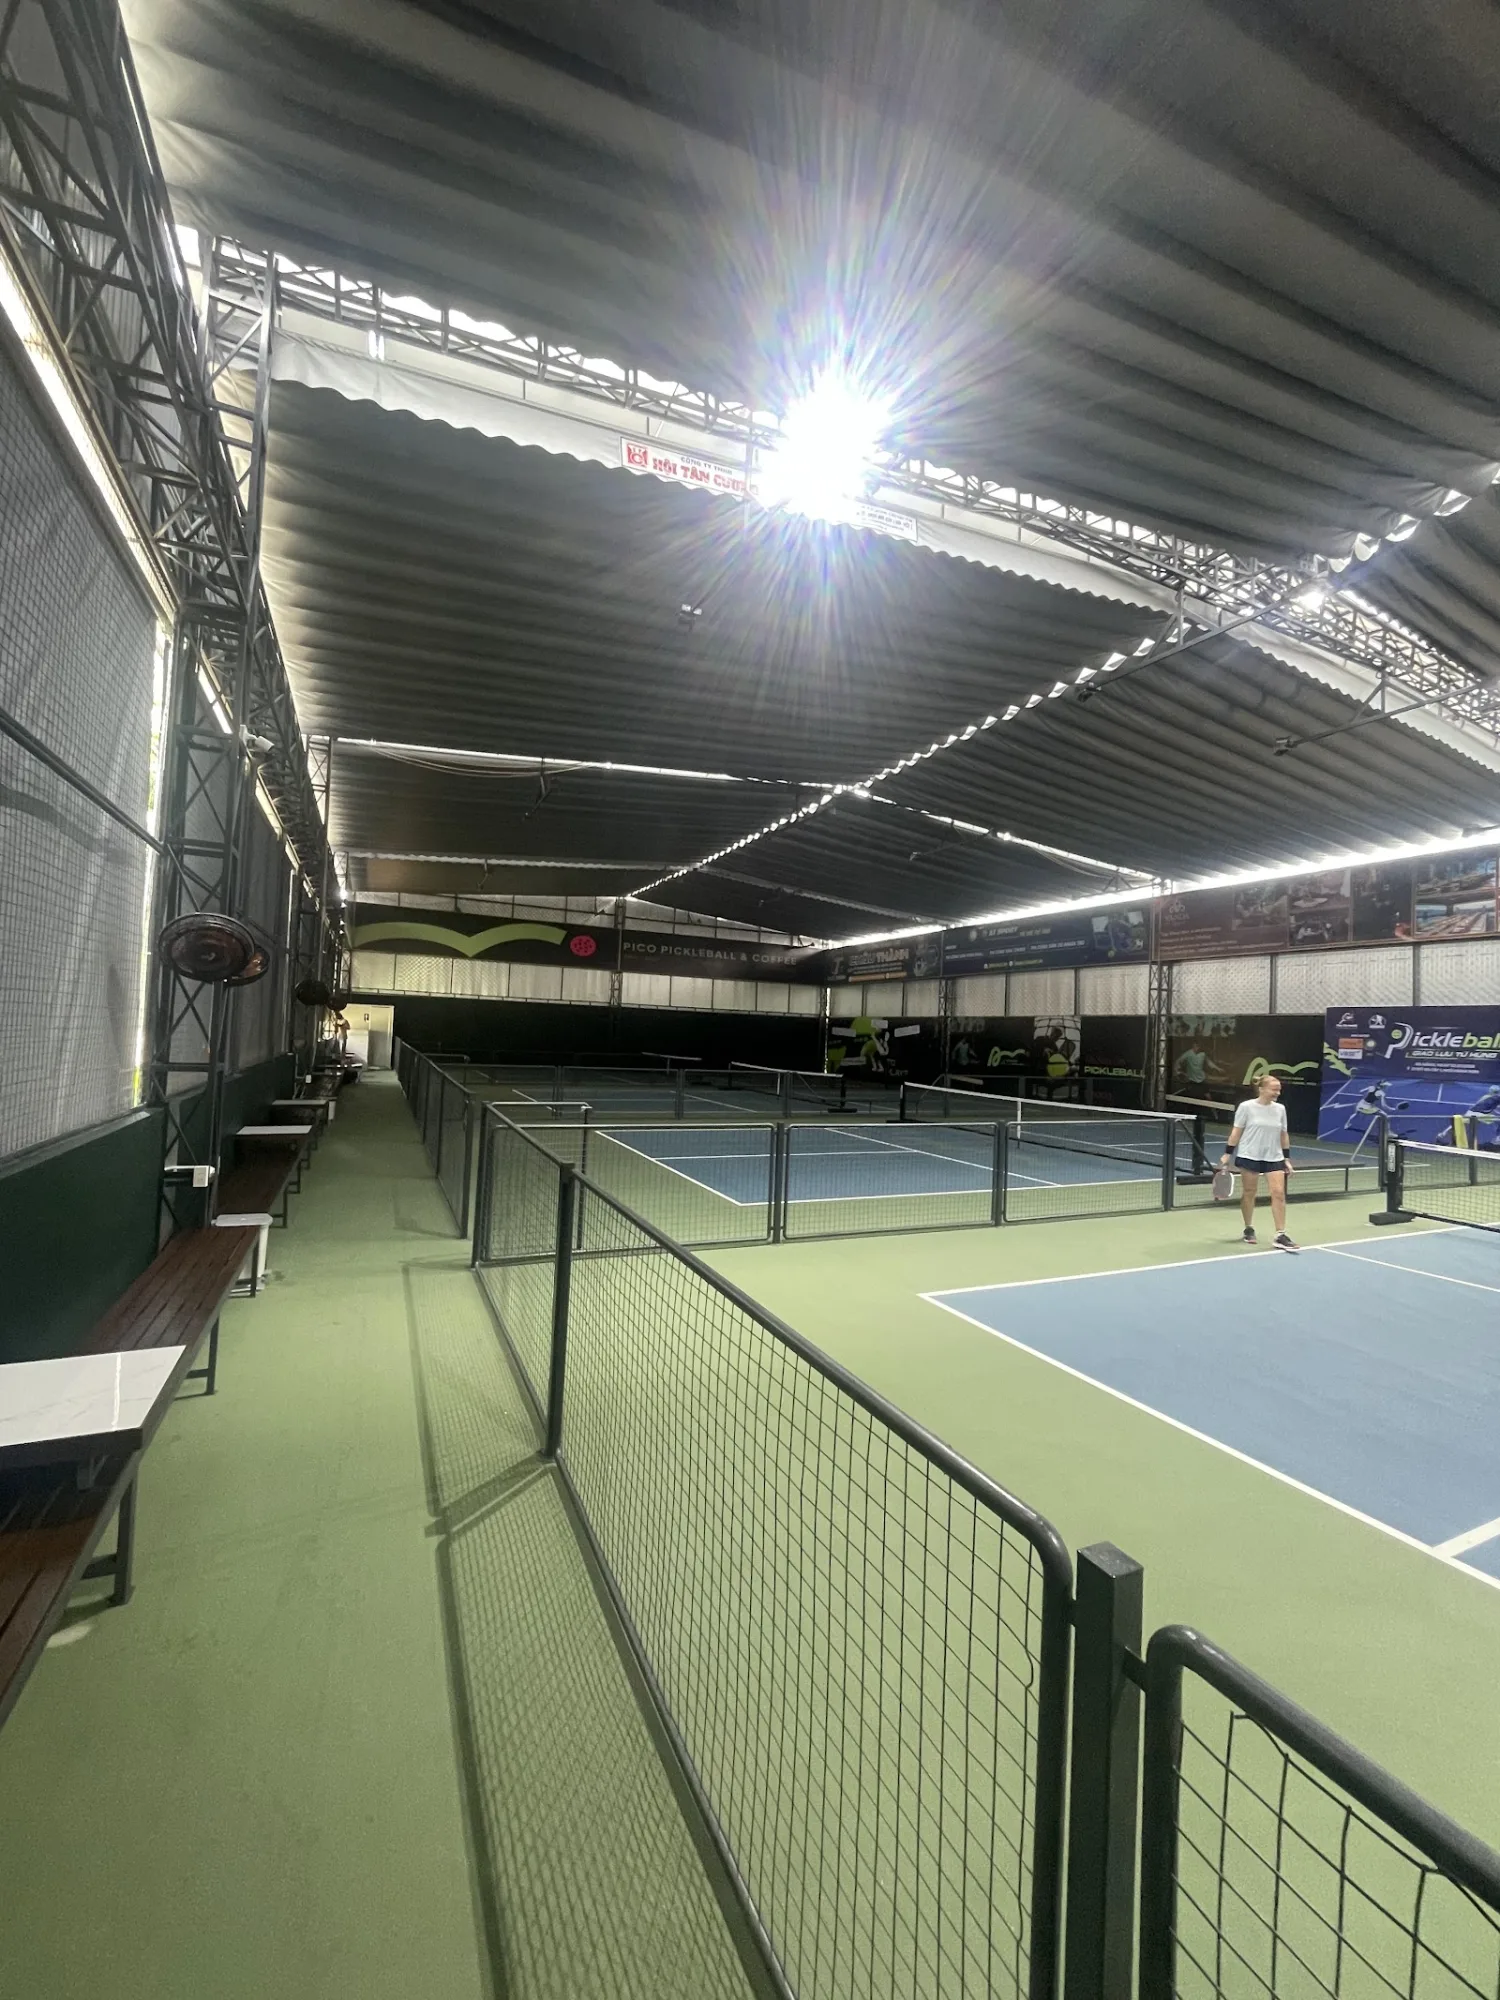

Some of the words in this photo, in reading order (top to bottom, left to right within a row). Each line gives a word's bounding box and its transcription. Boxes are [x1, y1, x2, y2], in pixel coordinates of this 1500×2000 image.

[623, 942, 657, 954] PICO
[660, 945, 736, 960] PICKLEBALL
[1384, 1022, 1500, 1058] Picklebal
